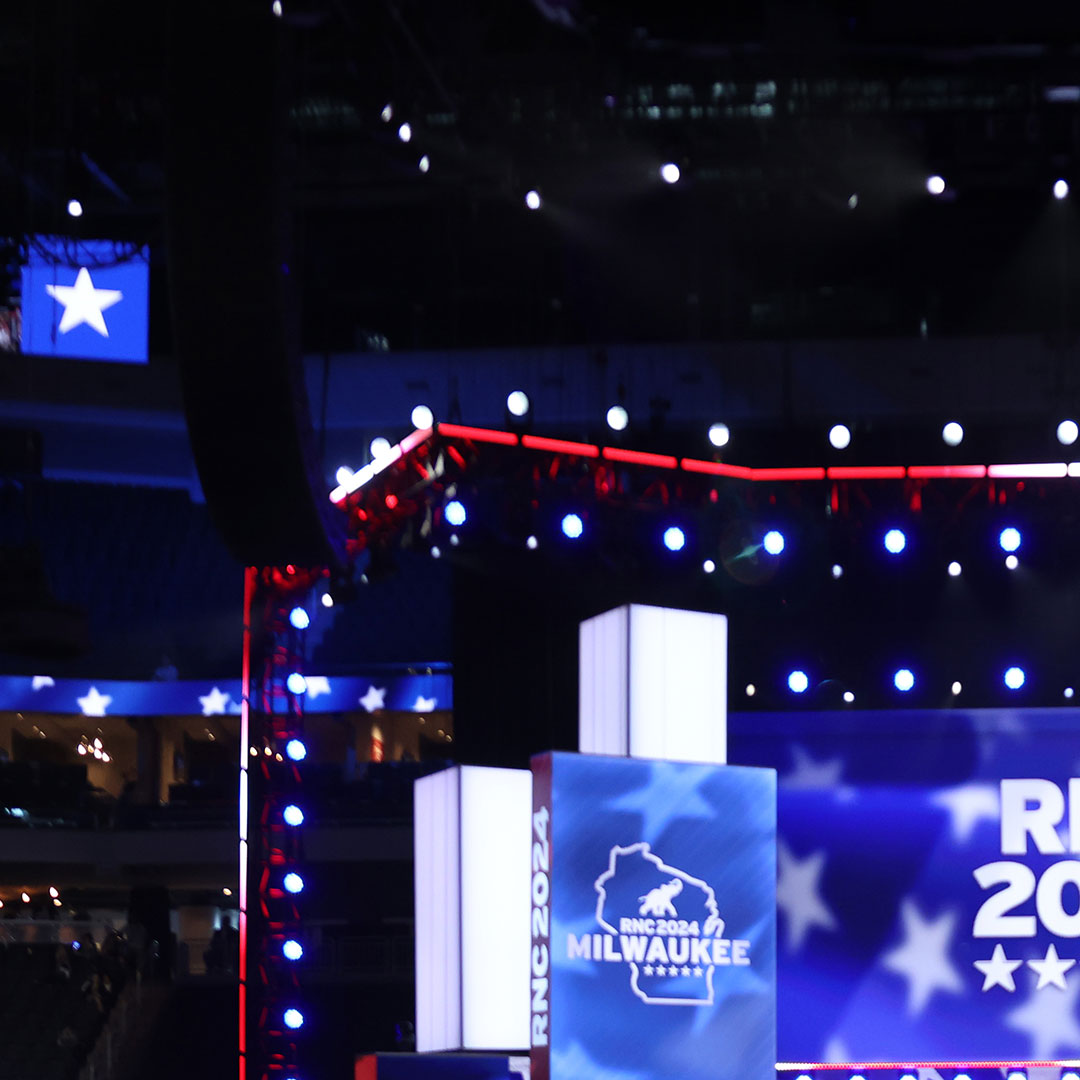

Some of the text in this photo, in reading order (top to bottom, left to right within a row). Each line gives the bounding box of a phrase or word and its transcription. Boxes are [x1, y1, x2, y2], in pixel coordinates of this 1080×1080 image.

[531, 806, 550, 1047] RNC 2024
[620, 917, 699, 936] RNC 2024
[566, 933, 751, 966] MILWAUKEE
